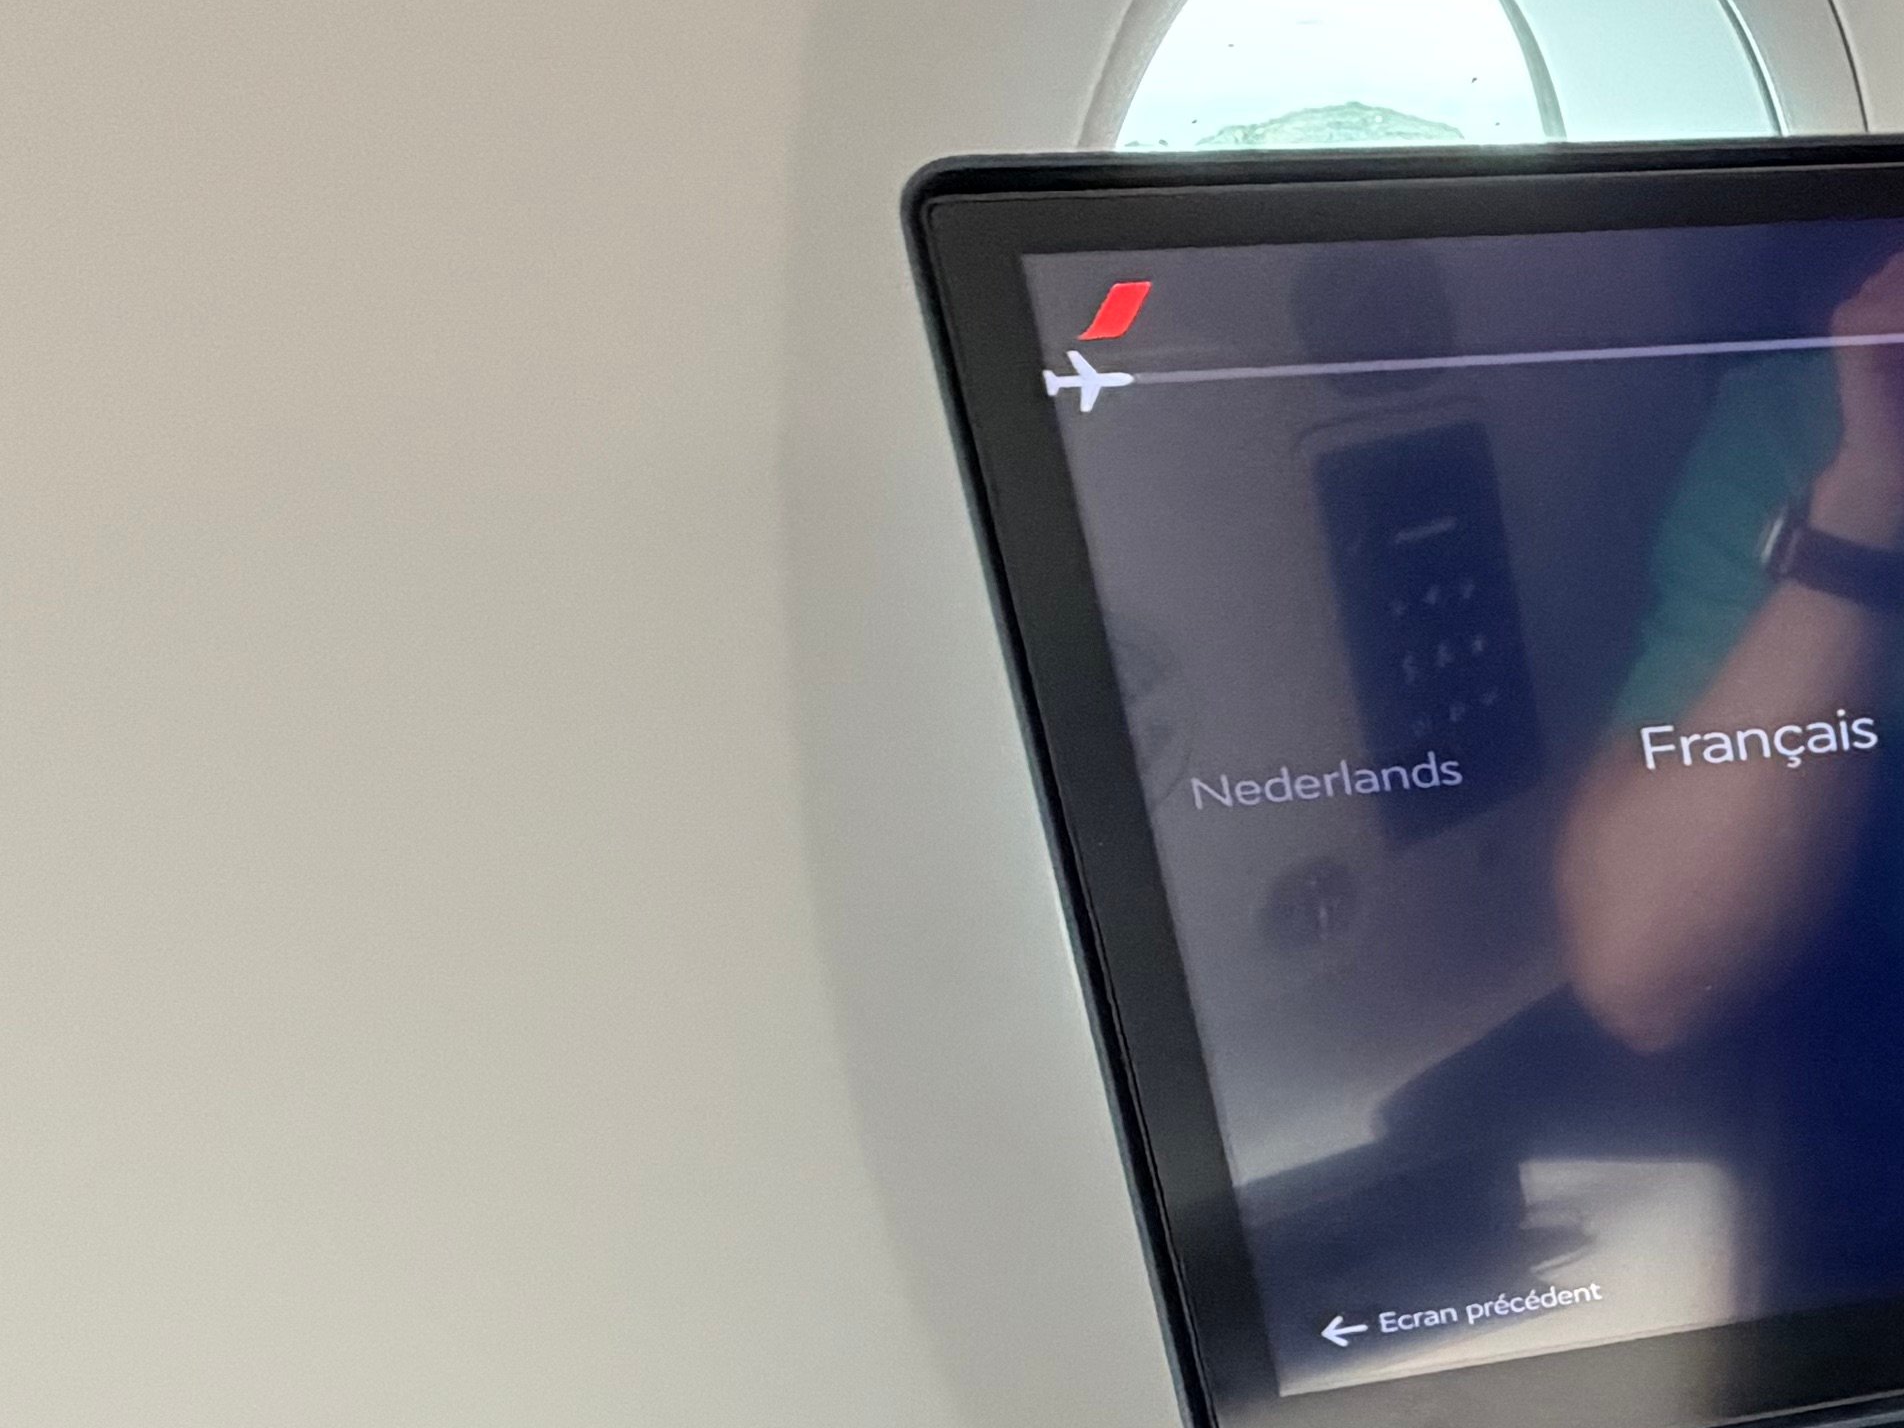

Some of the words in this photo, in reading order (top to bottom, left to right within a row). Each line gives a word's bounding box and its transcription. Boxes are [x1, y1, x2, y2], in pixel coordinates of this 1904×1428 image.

[1640, 709, 1879, 773] Français
[1192, 749, 1463, 811] Nederlands
[1379, 1307, 1458, 1334] Ecran
[1466, 1282, 1603, 1324] précédent
